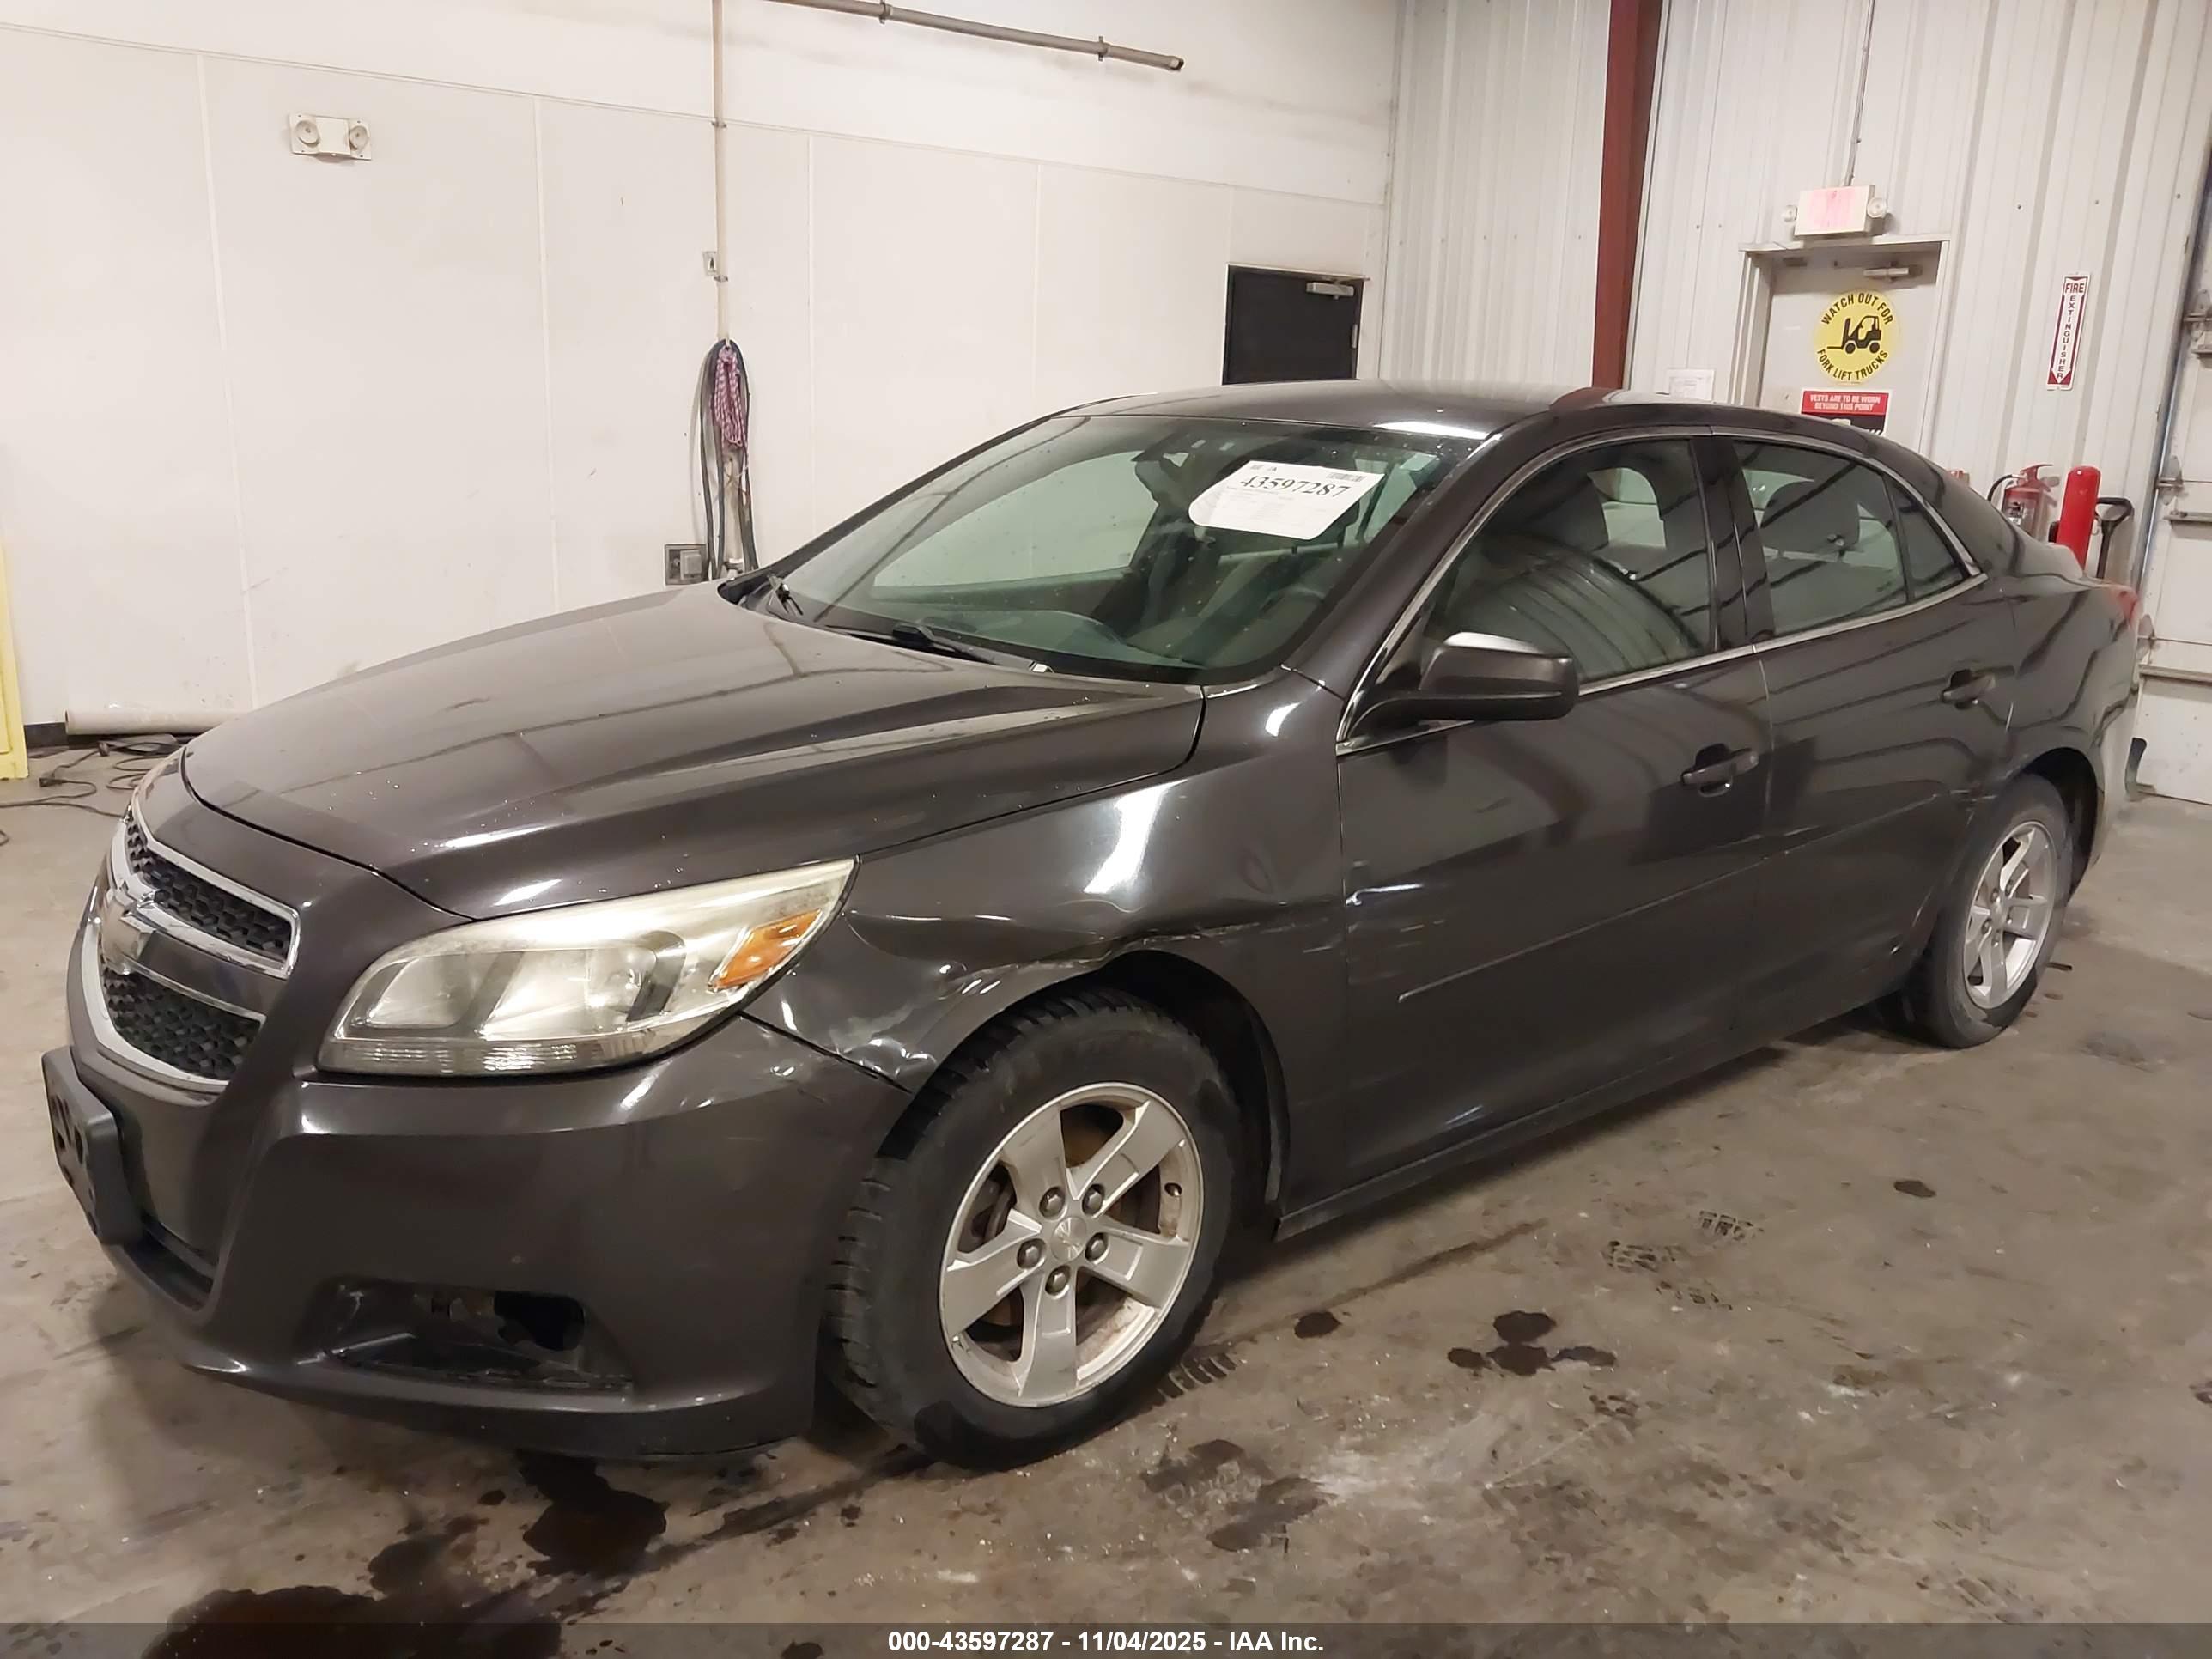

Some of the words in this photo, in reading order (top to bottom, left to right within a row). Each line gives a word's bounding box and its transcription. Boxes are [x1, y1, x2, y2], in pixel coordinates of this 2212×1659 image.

[2064, 283, 2085, 294] FIRE
[1821, 294, 1855, 325] WATCH
[1857, 292, 1879, 307] OUT
[1877, 302, 1893, 325] FOR
[2057, 295, 2076, 379] EXTINGUISHER
[1817, 349, 1834, 374] FORK
[1832, 368, 1852, 380] LIFT
[1855, 350, 1888, 380] TRUCKS
[1241, 475, 1351, 497] 43597287
